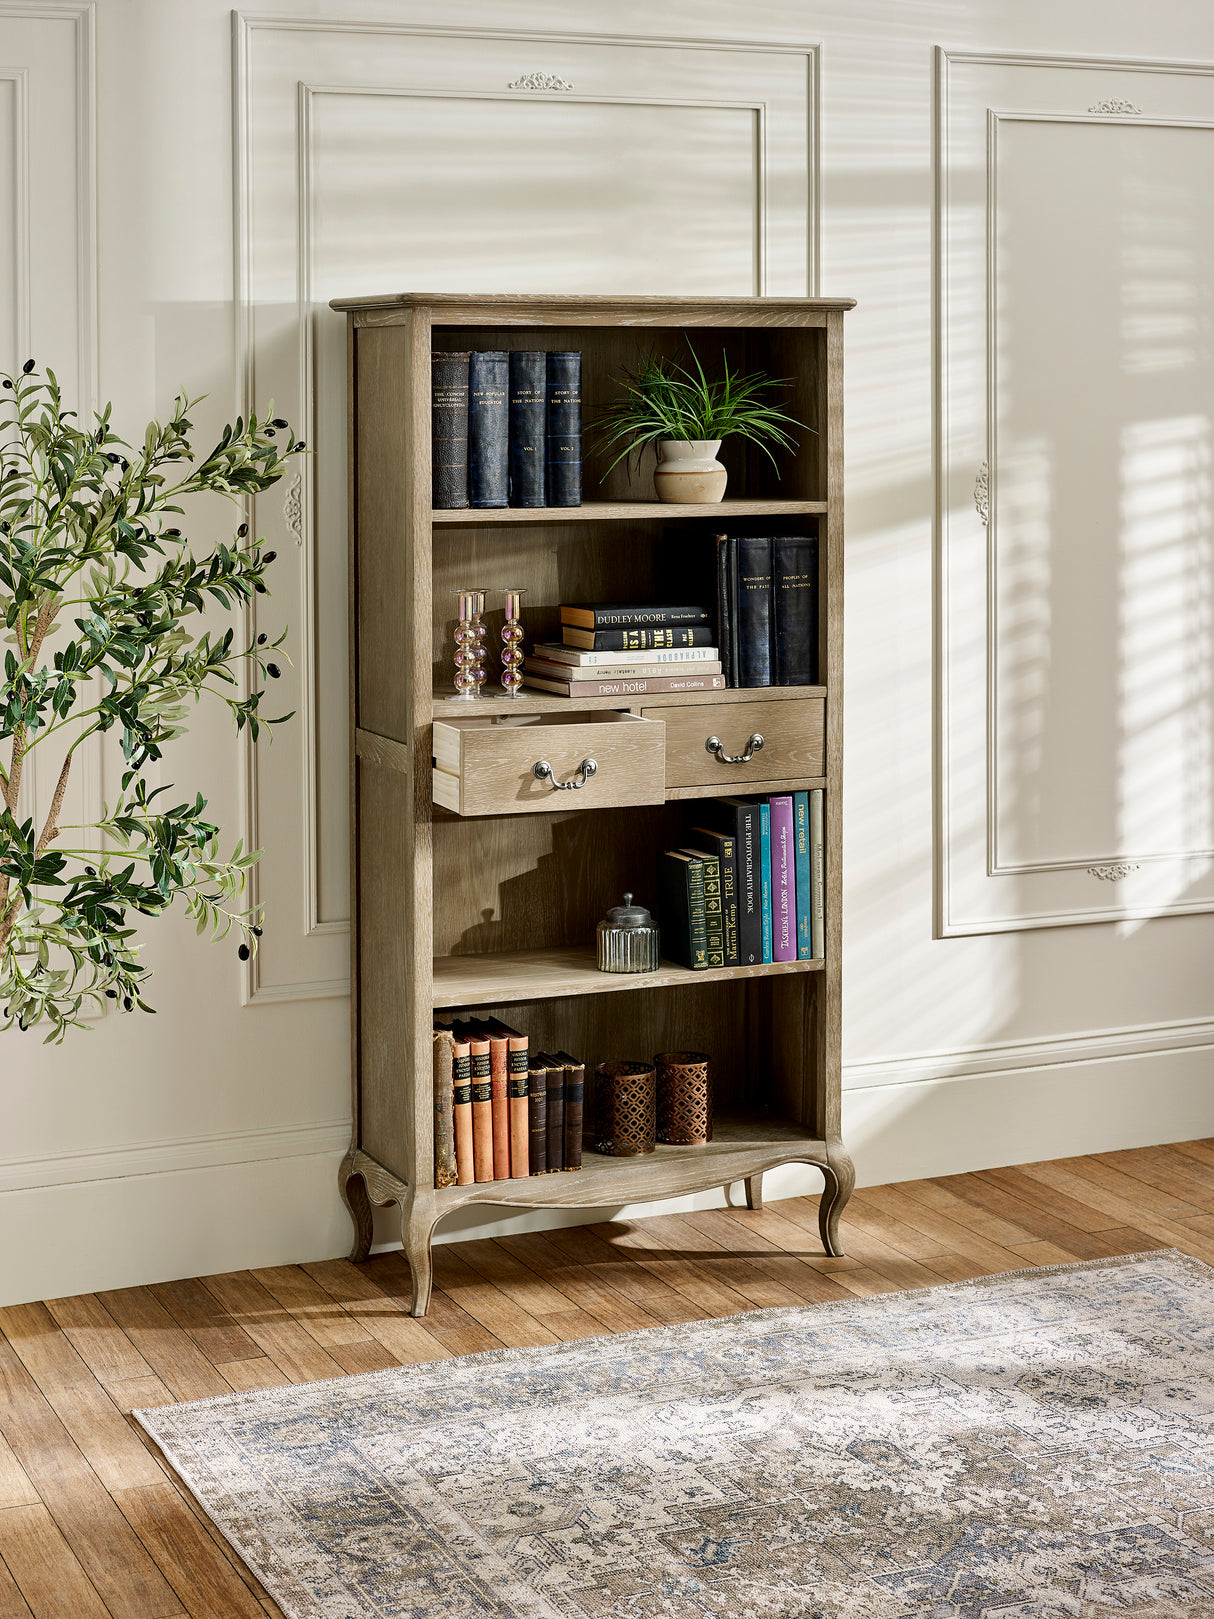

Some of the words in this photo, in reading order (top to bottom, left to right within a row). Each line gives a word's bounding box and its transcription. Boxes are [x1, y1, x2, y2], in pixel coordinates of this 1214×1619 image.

[597, 614, 633, 624] DUDLEY
[634, 613, 667, 623] MOORE
[629, 639, 639, 649] IS
[653, 629, 664, 648] THE
[665, 629, 673, 648] CLASH
[657, 650, 706, 663] ALPHABOOK
[599, 684, 620, 693] new
[622, 680, 647, 692] hotel
[744, 814, 752, 831] THE
[798, 804, 806, 825] new
[798, 828, 807, 854] retail
[745, 833, 753, 892] PHOTOGRAPHY
[724, 867, 734, 899] TRUE
[780, 888, 789, 914] LONDON
[728, 903, 737, 928] Kemp
[729, 930, 738, 960] Martin
